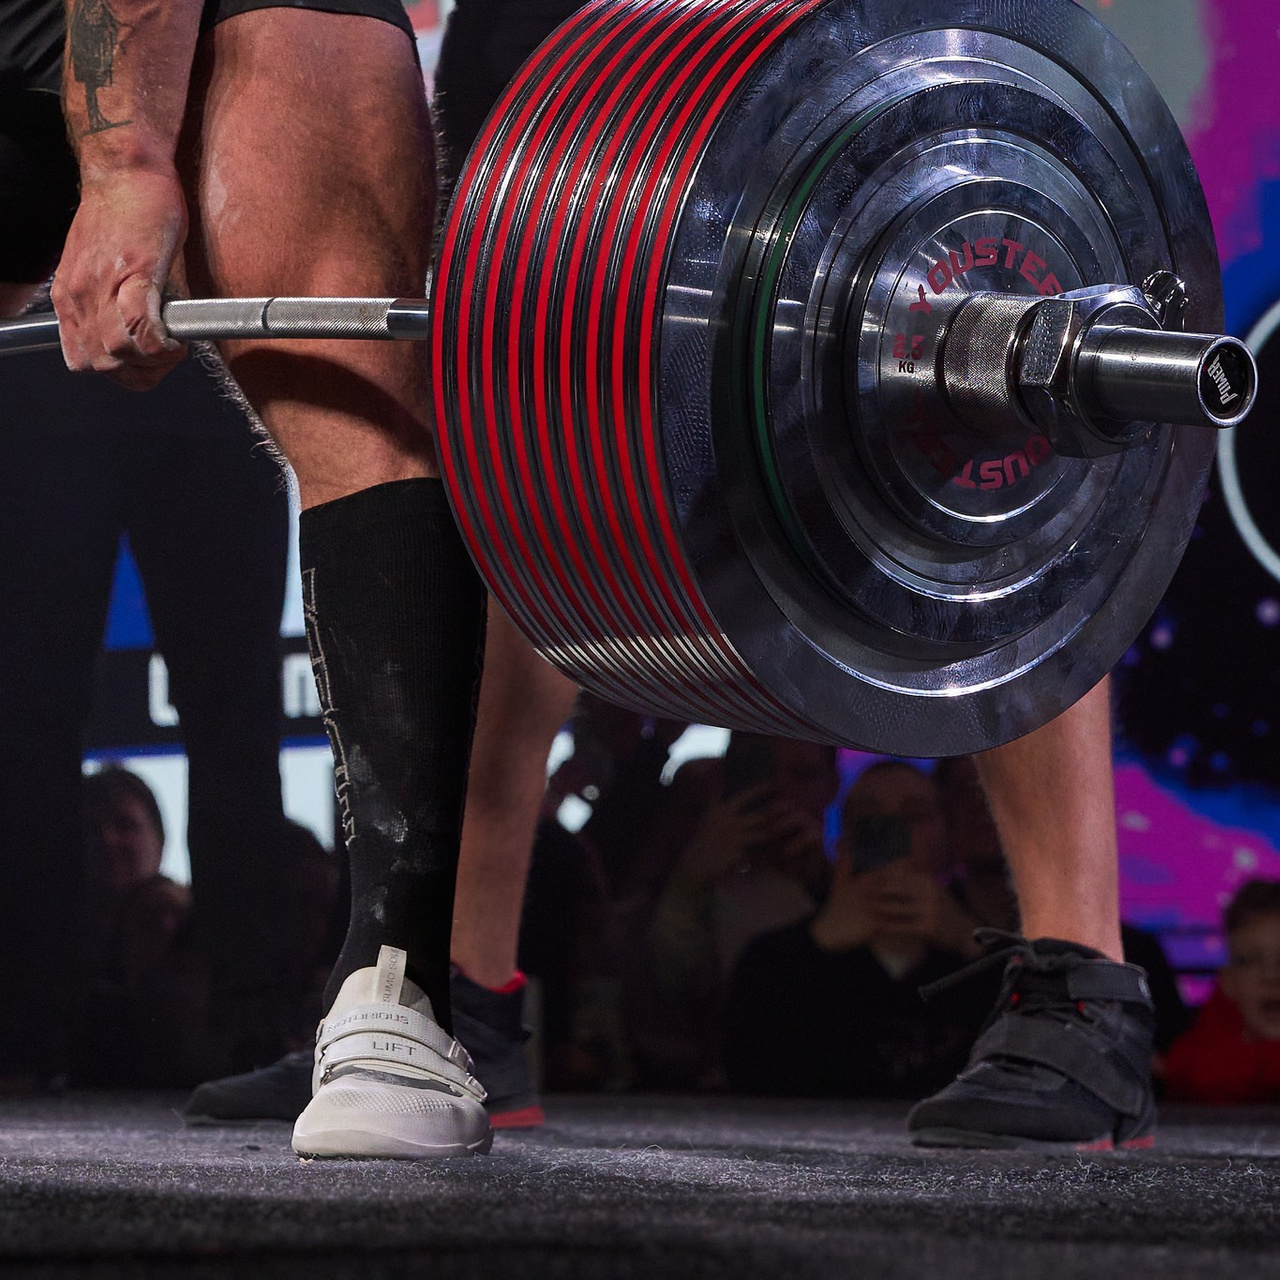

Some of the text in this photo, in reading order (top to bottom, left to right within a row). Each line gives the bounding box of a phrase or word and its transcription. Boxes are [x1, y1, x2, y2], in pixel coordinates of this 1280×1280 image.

[908, 237, 1064, 316] YOUSTEE
[898, 360, 915, 374] KG
[1206, 353, 1239, 405] POWER
[372, 1041, 417, 1056] LIFT
